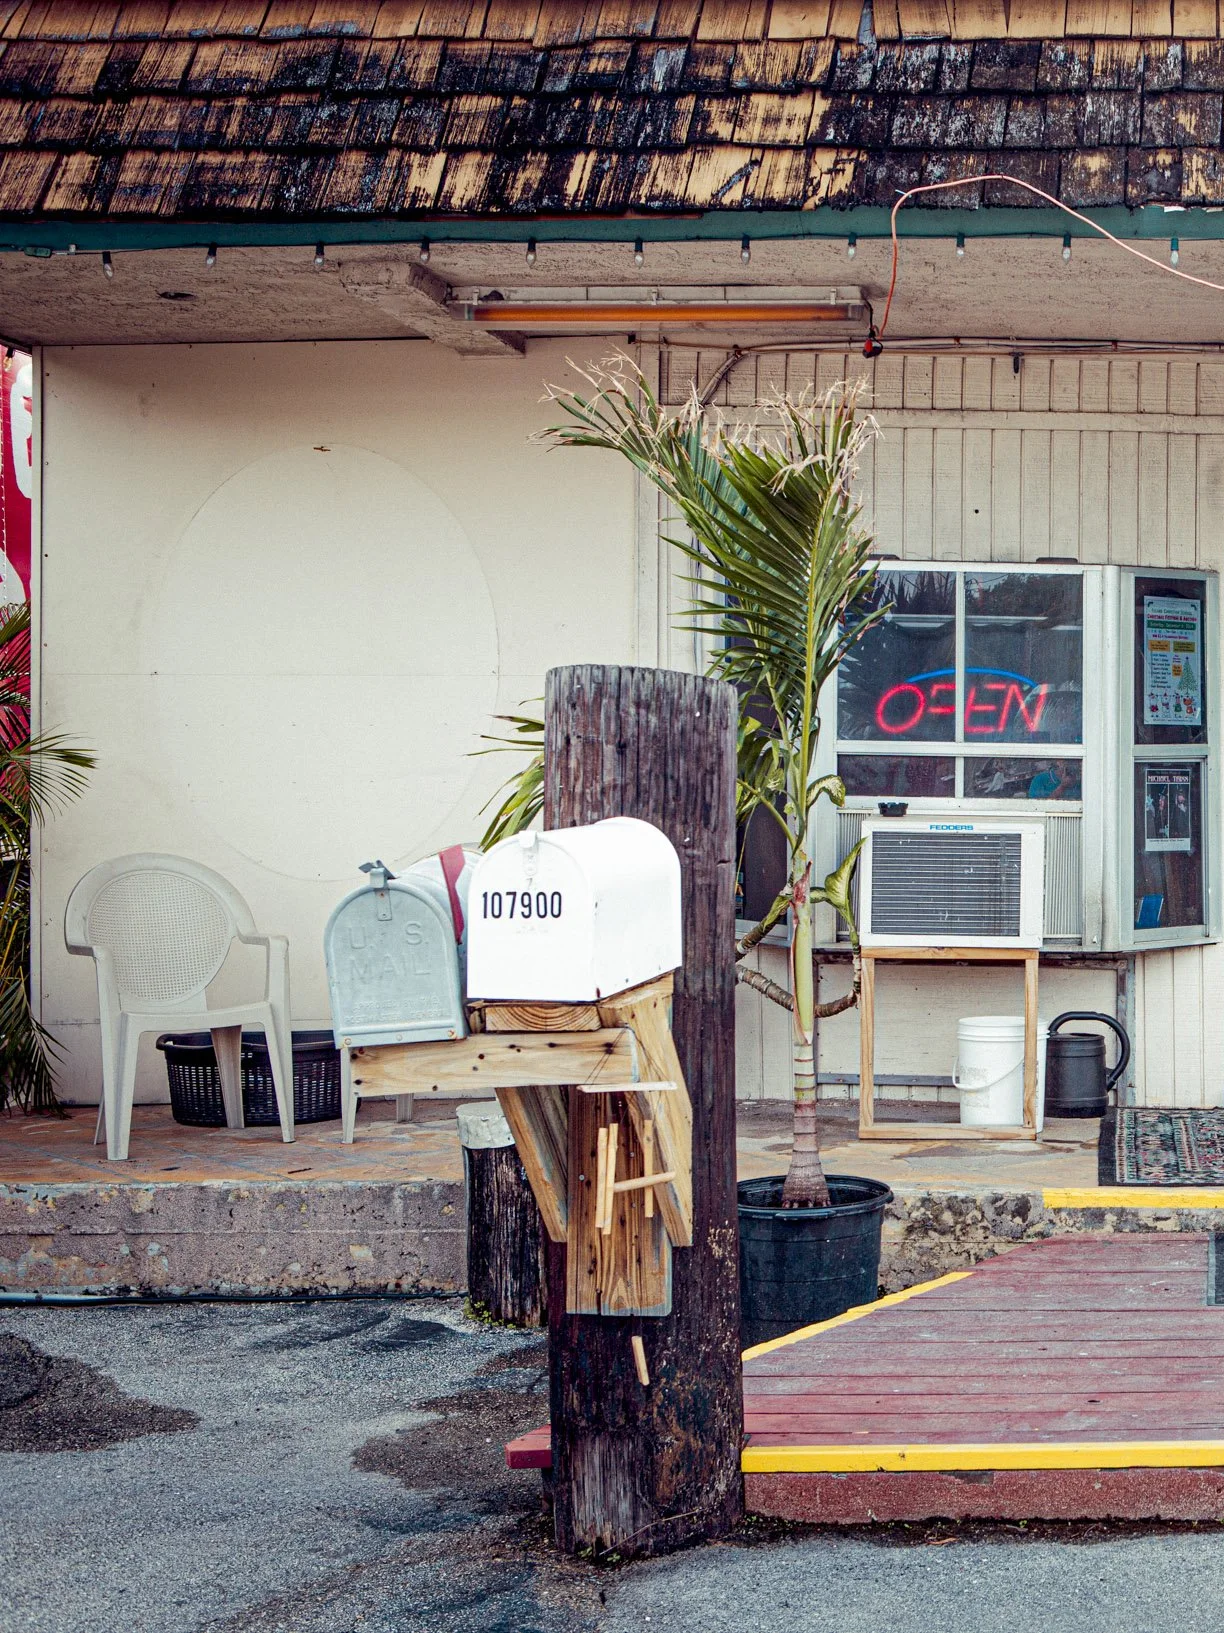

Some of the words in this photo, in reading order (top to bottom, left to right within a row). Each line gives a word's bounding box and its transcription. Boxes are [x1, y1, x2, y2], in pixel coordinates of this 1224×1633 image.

[876, 683, 1048, 734] OPEN
[482, 891, 562, 919] 107900
[350, 954, 431, 981] MAIL
